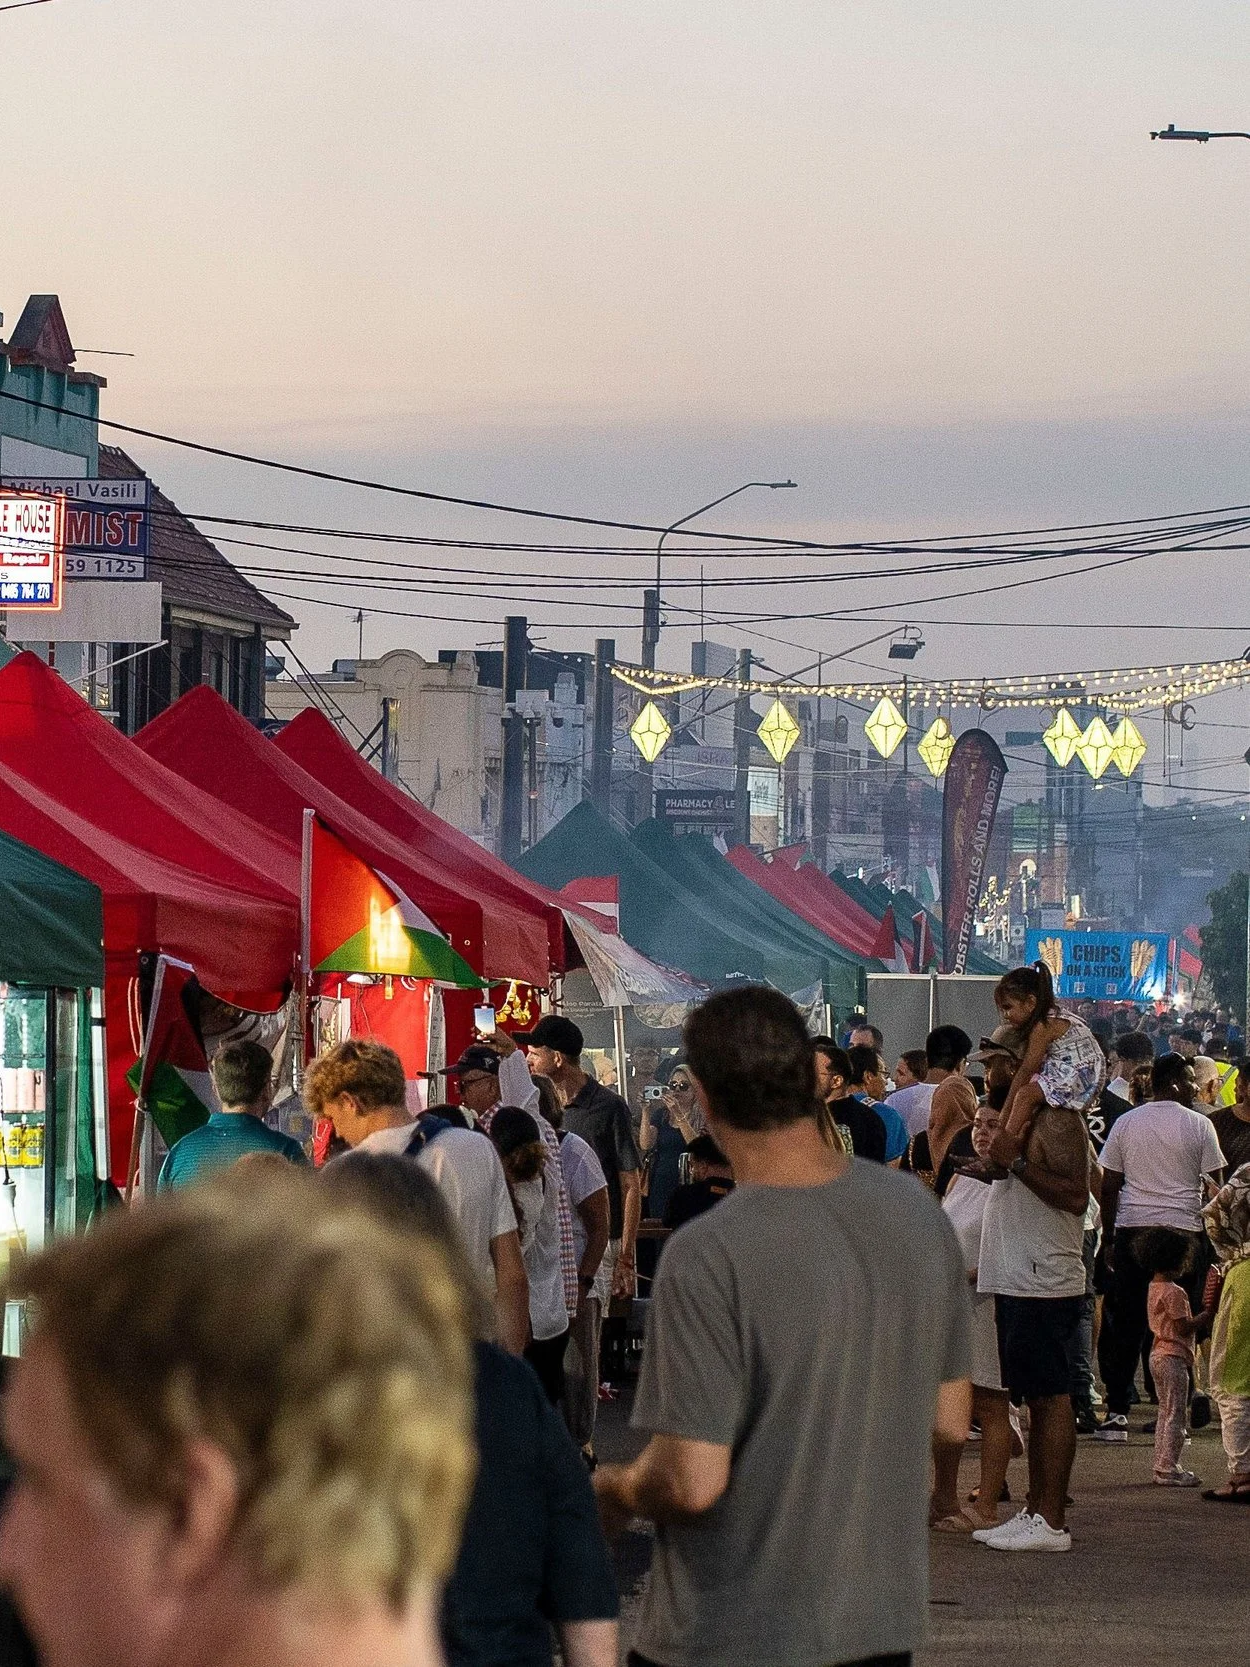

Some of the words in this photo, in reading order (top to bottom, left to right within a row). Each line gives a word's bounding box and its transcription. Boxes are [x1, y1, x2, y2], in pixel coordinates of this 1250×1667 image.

[88, 483, 137, 498] Vasili
[15, 504, 51, 533] HOUSE
[2, 552, 46, 566] Repair
[95, 560, 137, 574] 1125
[980, 764, 1002, 819] MORE!
[665, 798, 713, 808] PHARMACY
[973, 819, 990, 855] AND
[965, 857, 983, 910] ROLLS
[952, 910, 972, 976] OBSTER
[1072, 945, 1121, 962] CHIPS
[1066, 965, 1080, 977] ON
[1084, 965, 1093, 977] A
[1093, 965, 1126, 978] STICK
